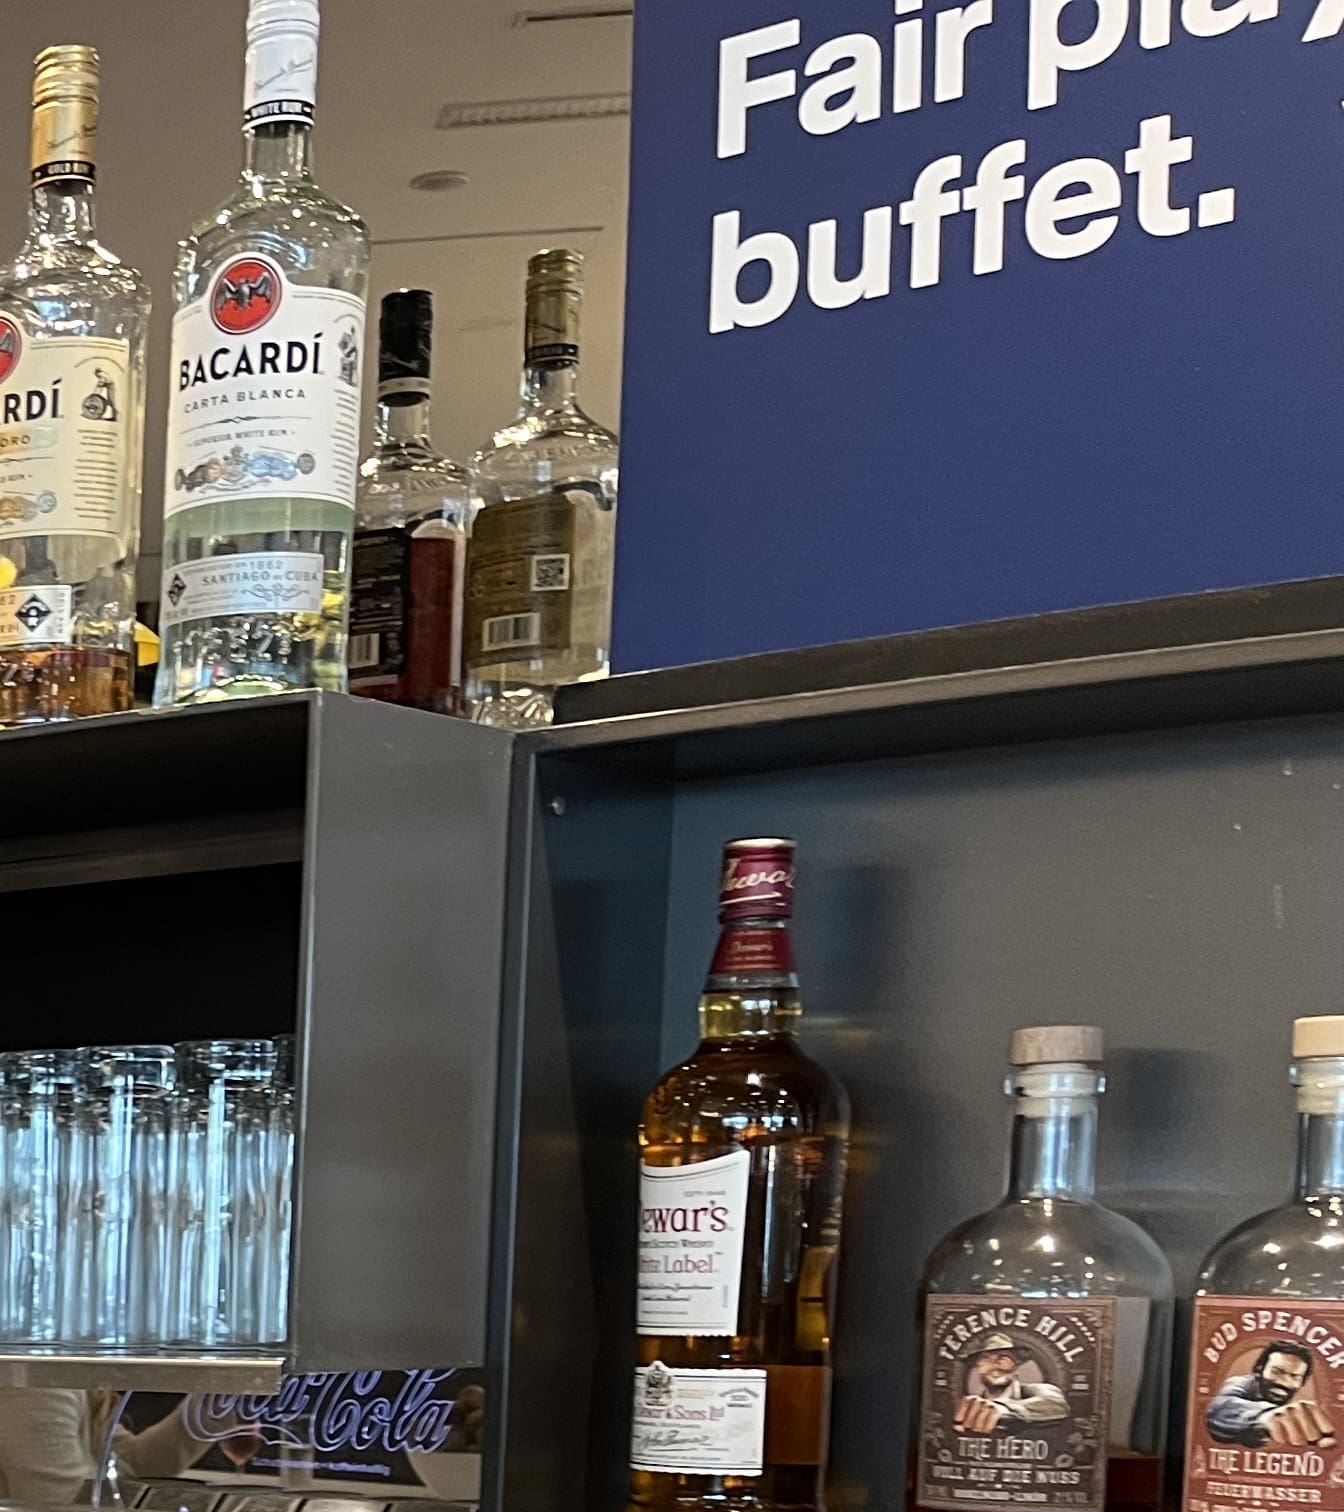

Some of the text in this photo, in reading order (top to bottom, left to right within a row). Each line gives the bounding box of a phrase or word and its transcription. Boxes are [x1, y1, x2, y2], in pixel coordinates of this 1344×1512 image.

[717, 0, 992, 159] Fair
[709, 114, 1236, 334] buffet.
[178, 331, 324, 392] BACARDÍ
[184, 388, 306, 414] CARTA BLANCA
[202, 569, 270, 586] SANTIAGO
[664, 1254, 713, 1273] Label
[939, 1307, 1084, 1363] TERENCE HILL
[1203, 1322, 1238, 1363] BUD
[958, 1436, 1049, 1460] THE HERO
[1208, 1448, 1325, 1477] THE LEGEND
[1035, 1471, 1081, 1484] NUSS
[1206, 1481, 1321, 1503] FEUERWASSER
